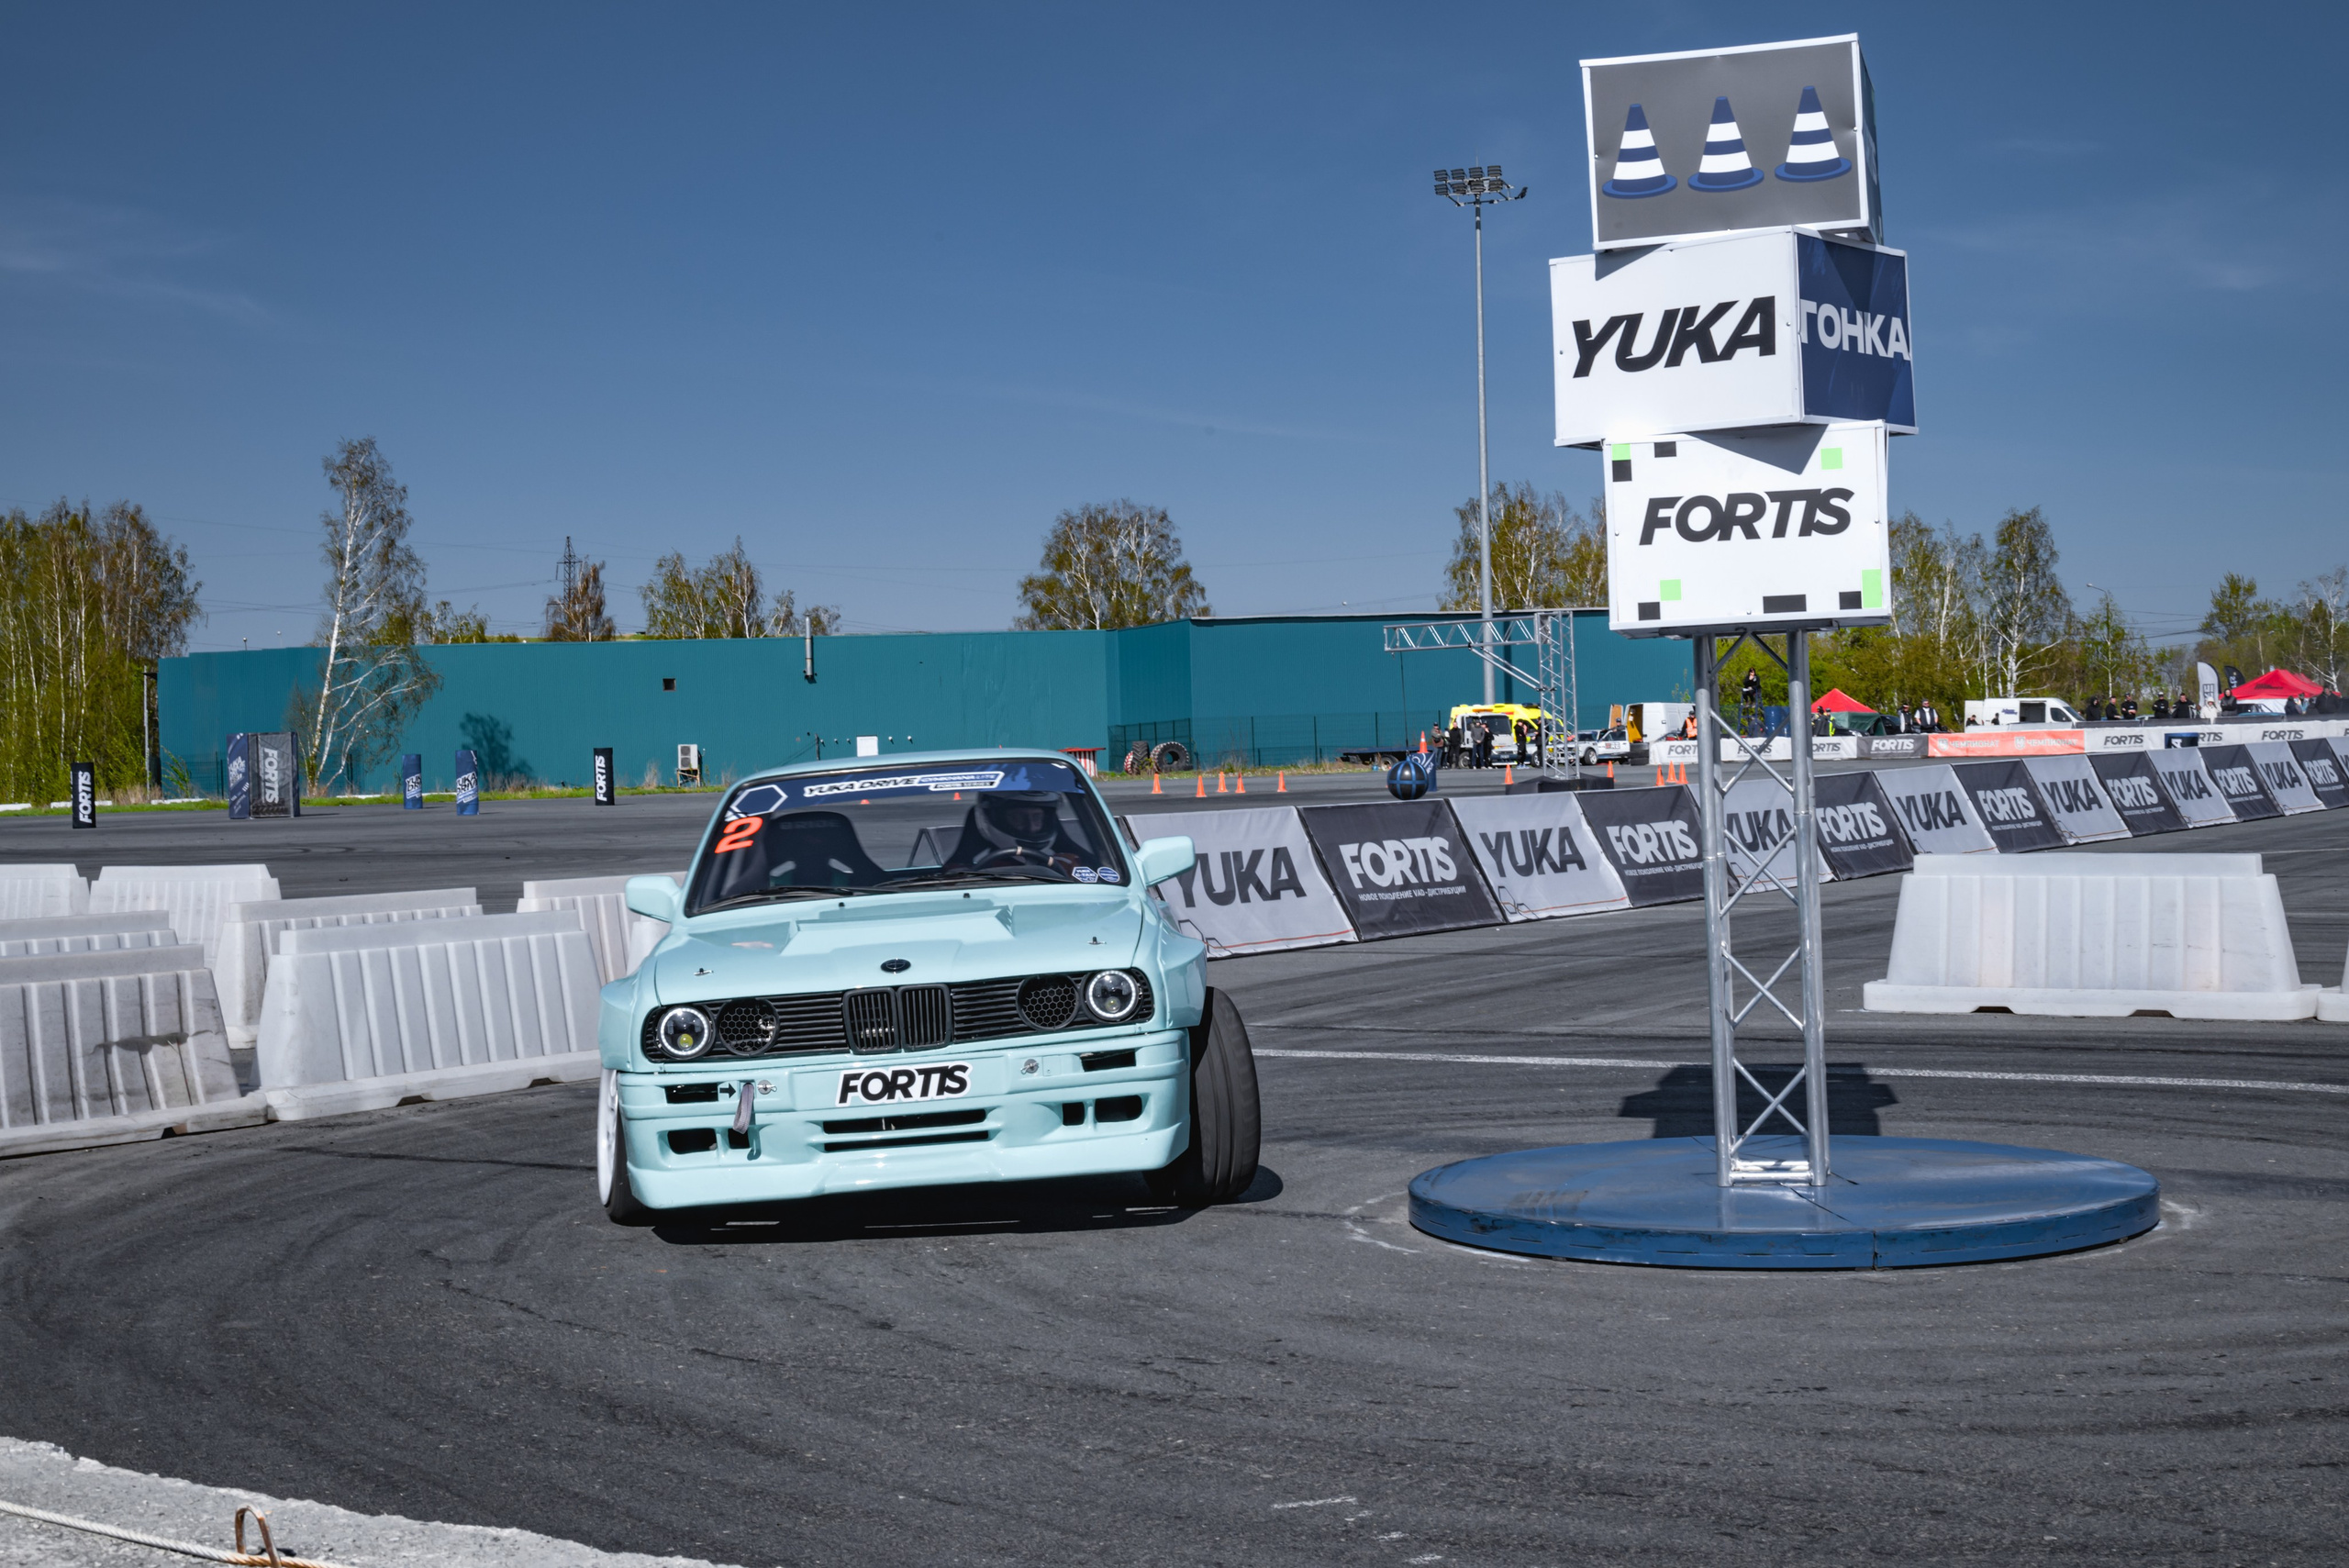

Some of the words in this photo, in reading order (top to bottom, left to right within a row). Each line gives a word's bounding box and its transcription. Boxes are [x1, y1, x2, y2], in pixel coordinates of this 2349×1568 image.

[1572, 295, 1776, 379] YUKA
[1799, 298, 1911, 361] ГОНКА
[1639, 487, 1855, 546] FORTIS
[1667, 744, 1698, 755] FORT
[1812, 742, 1842, 752] ORTIS
[1871, 739, 1915, 751] FORTIS
[1949, 740, 2000, 748] ЧЕМПИОНАТ
[2026, 738, 2078, 747] ЧЕМПИОНАТ
[2103, 734, 2144, 746] FORTIS
[2199, 732, 2223, 742] RTIS
[2261, 729, 2304, 741] FORTIS
[263, 747, 279, 805] FORTIS
[595, 755, 607, 802] FORTIS
[807, 782, 855, 795] YUKA
[859, 777, 918, 789] DRIVE
[2162, 769, 2213, 801] YUKA
[2214, 766, 2258, 796] FORTIS
[2259, 761, 2303, 791] YUKA
[2303, 758, 2340, 785] FORTIS
[79, 771, 93, 824] FORTIS
[1976, 787, 2036, 822] FORTIS
[2041, 778, 2104, 814] YUKA
[2106, 776, 2159, 808] FORTIS
[1816, 801, 1887, 843] FORTIS
[1896, 790, 1968, 832] YUKA
[714, 816, 764, 854] 2
[1479, 826, 1587, 878] YUKA
[1606, 819, 1698, 865] FORTIS
[1176, 846, 1308, 908] YUKA
[1339, 836, 1457, 889] FORTIS
[839, 1064, 969, 1104] FORTIS
